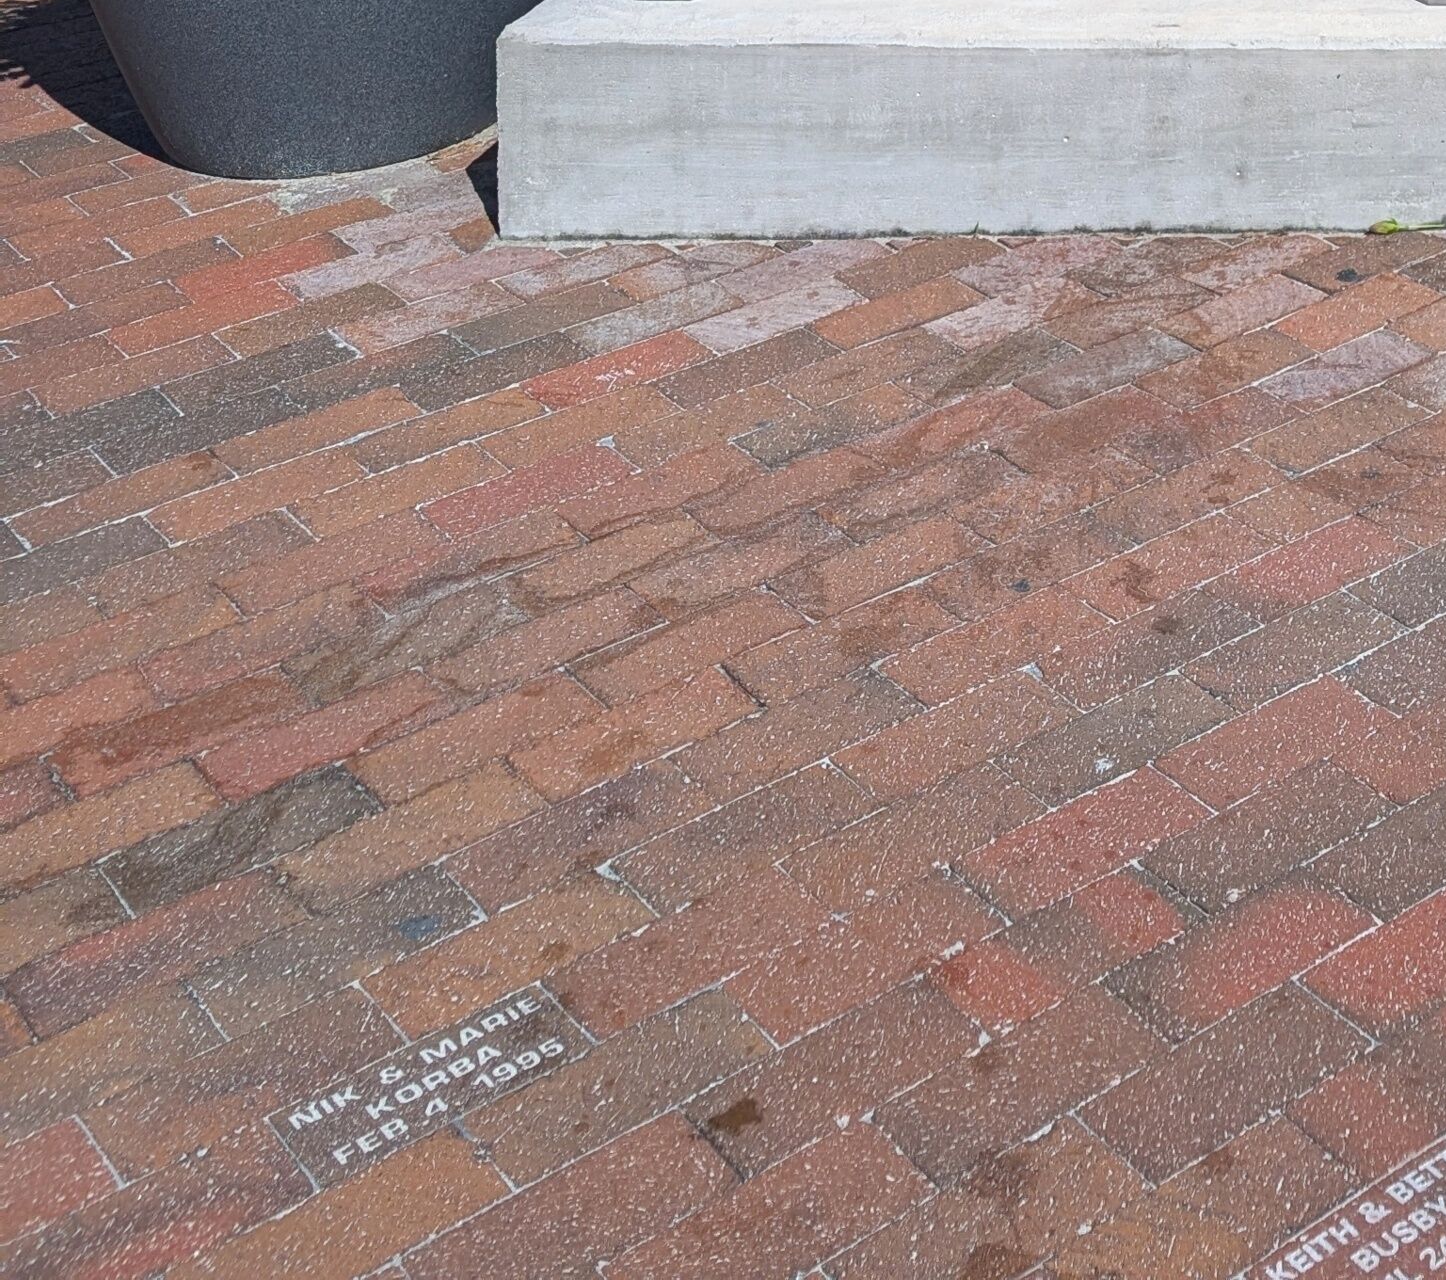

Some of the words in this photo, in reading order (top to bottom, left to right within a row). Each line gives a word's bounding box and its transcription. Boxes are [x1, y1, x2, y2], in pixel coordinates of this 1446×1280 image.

[288, 1085, 361, 1130] NIK
[380, 1065, 406, 1084] &
[418, 995, 544, 1064] MARIE
[332, 1118, 409, 1166] FEB
[424, 1097, 449, 1116] 4
[473, 1039, 564, 1089] 1995
[365, 1047, 503, 1120] KORBA
[1265, 1218, 1359, 1280] KEITH
[1359, 1202, 1391, 1224] &
